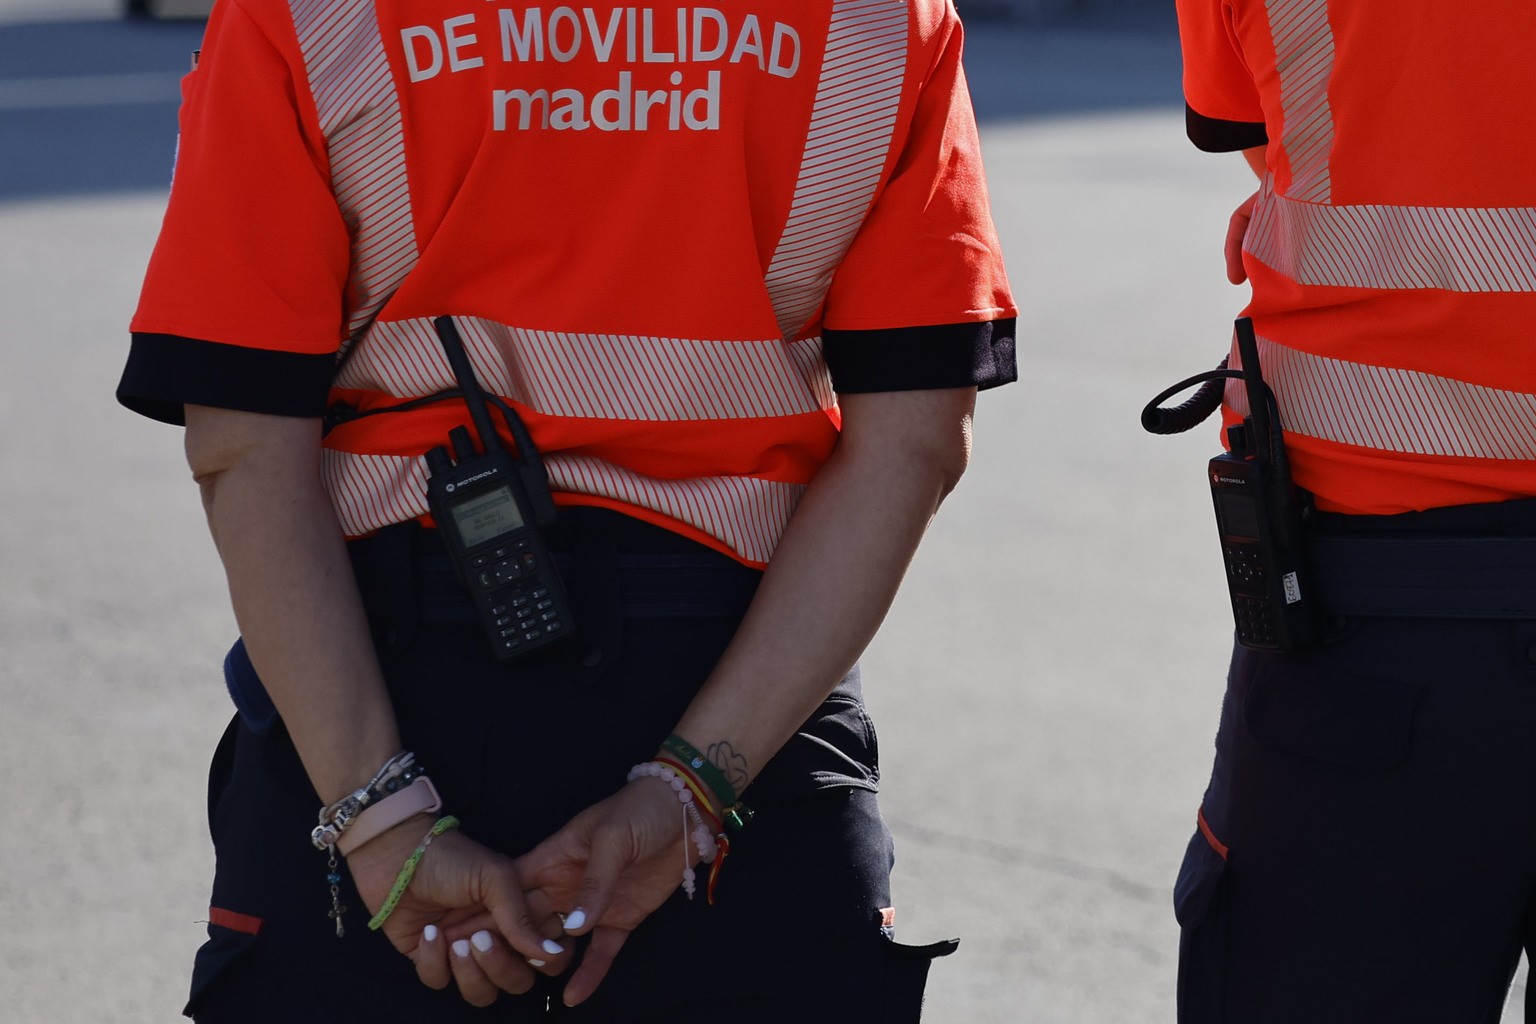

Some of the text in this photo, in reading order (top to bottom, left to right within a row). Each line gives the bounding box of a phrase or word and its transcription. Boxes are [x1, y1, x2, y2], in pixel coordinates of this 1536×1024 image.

[400, 5, 801, 83] DE MOVILIDAD
[492, 70, 722, 132] madrid
[456, 468, 498, 487] MOTOROLA
[1220, 477, 1246, 485] MOTOROLA
